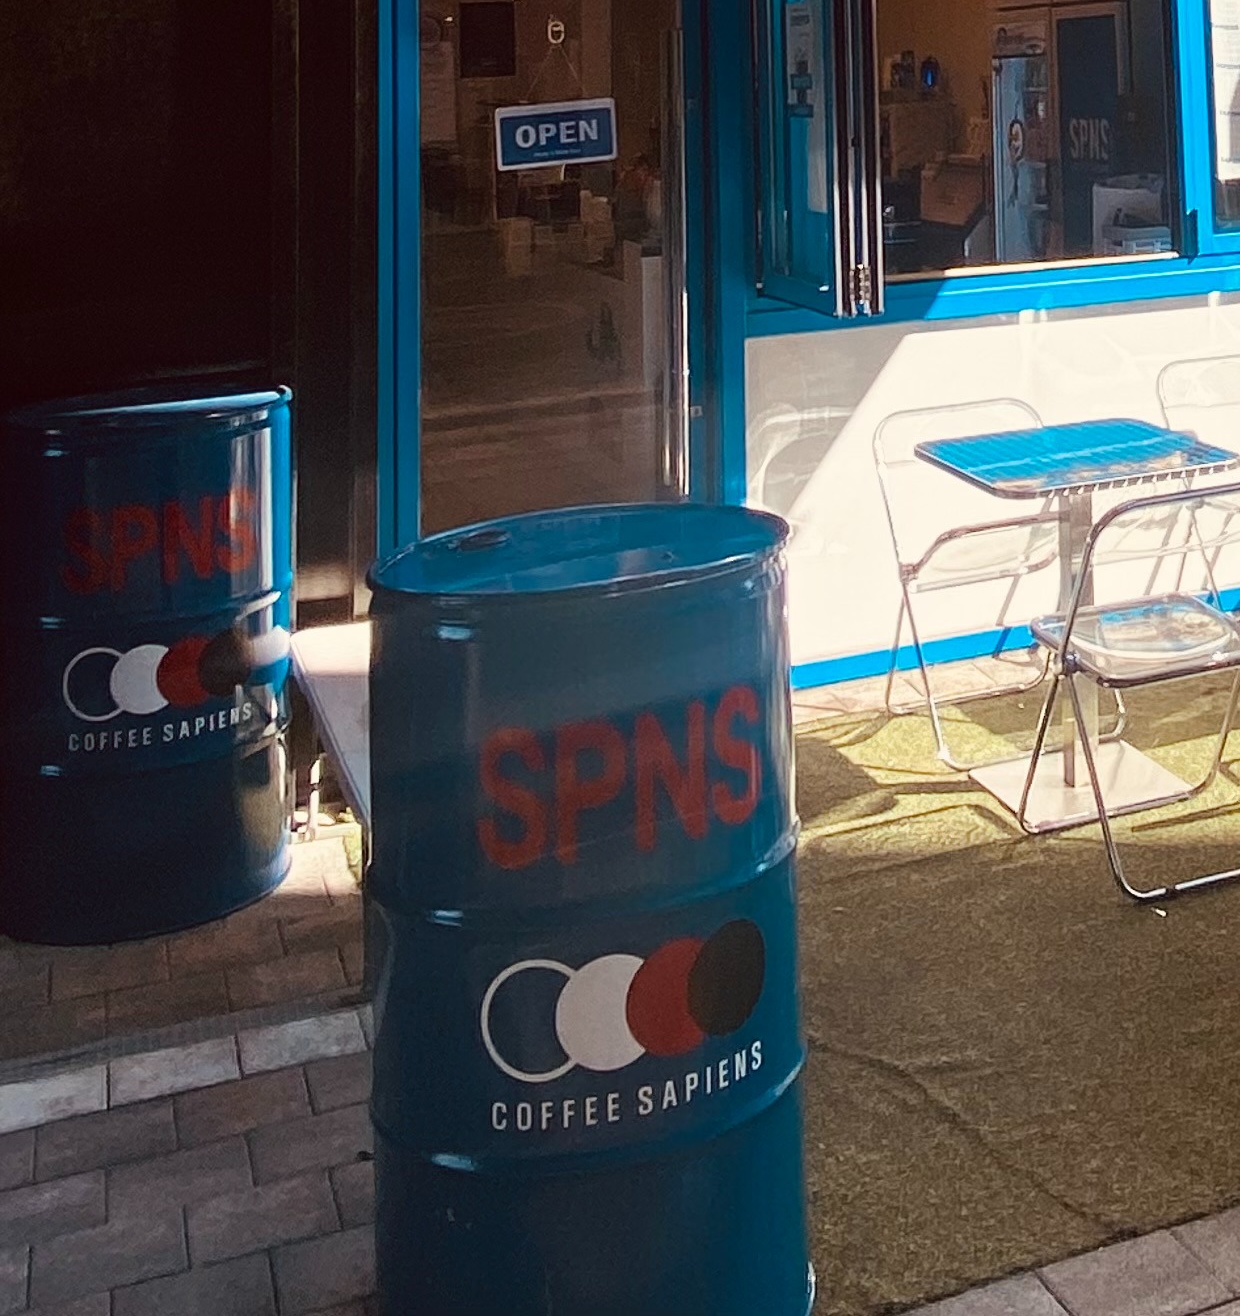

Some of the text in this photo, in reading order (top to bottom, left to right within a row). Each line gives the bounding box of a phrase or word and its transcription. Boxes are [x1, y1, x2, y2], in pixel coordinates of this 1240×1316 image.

[515, 118, 599, 149] OPEN
[61, 484, 256, 596] SPNS
[68, 702, 253, 753] COFFEE SAPIENS
[477, 684, 763, 870] SPNS
[491, 1039, 764, 1132] COFFEE SAPIENS
